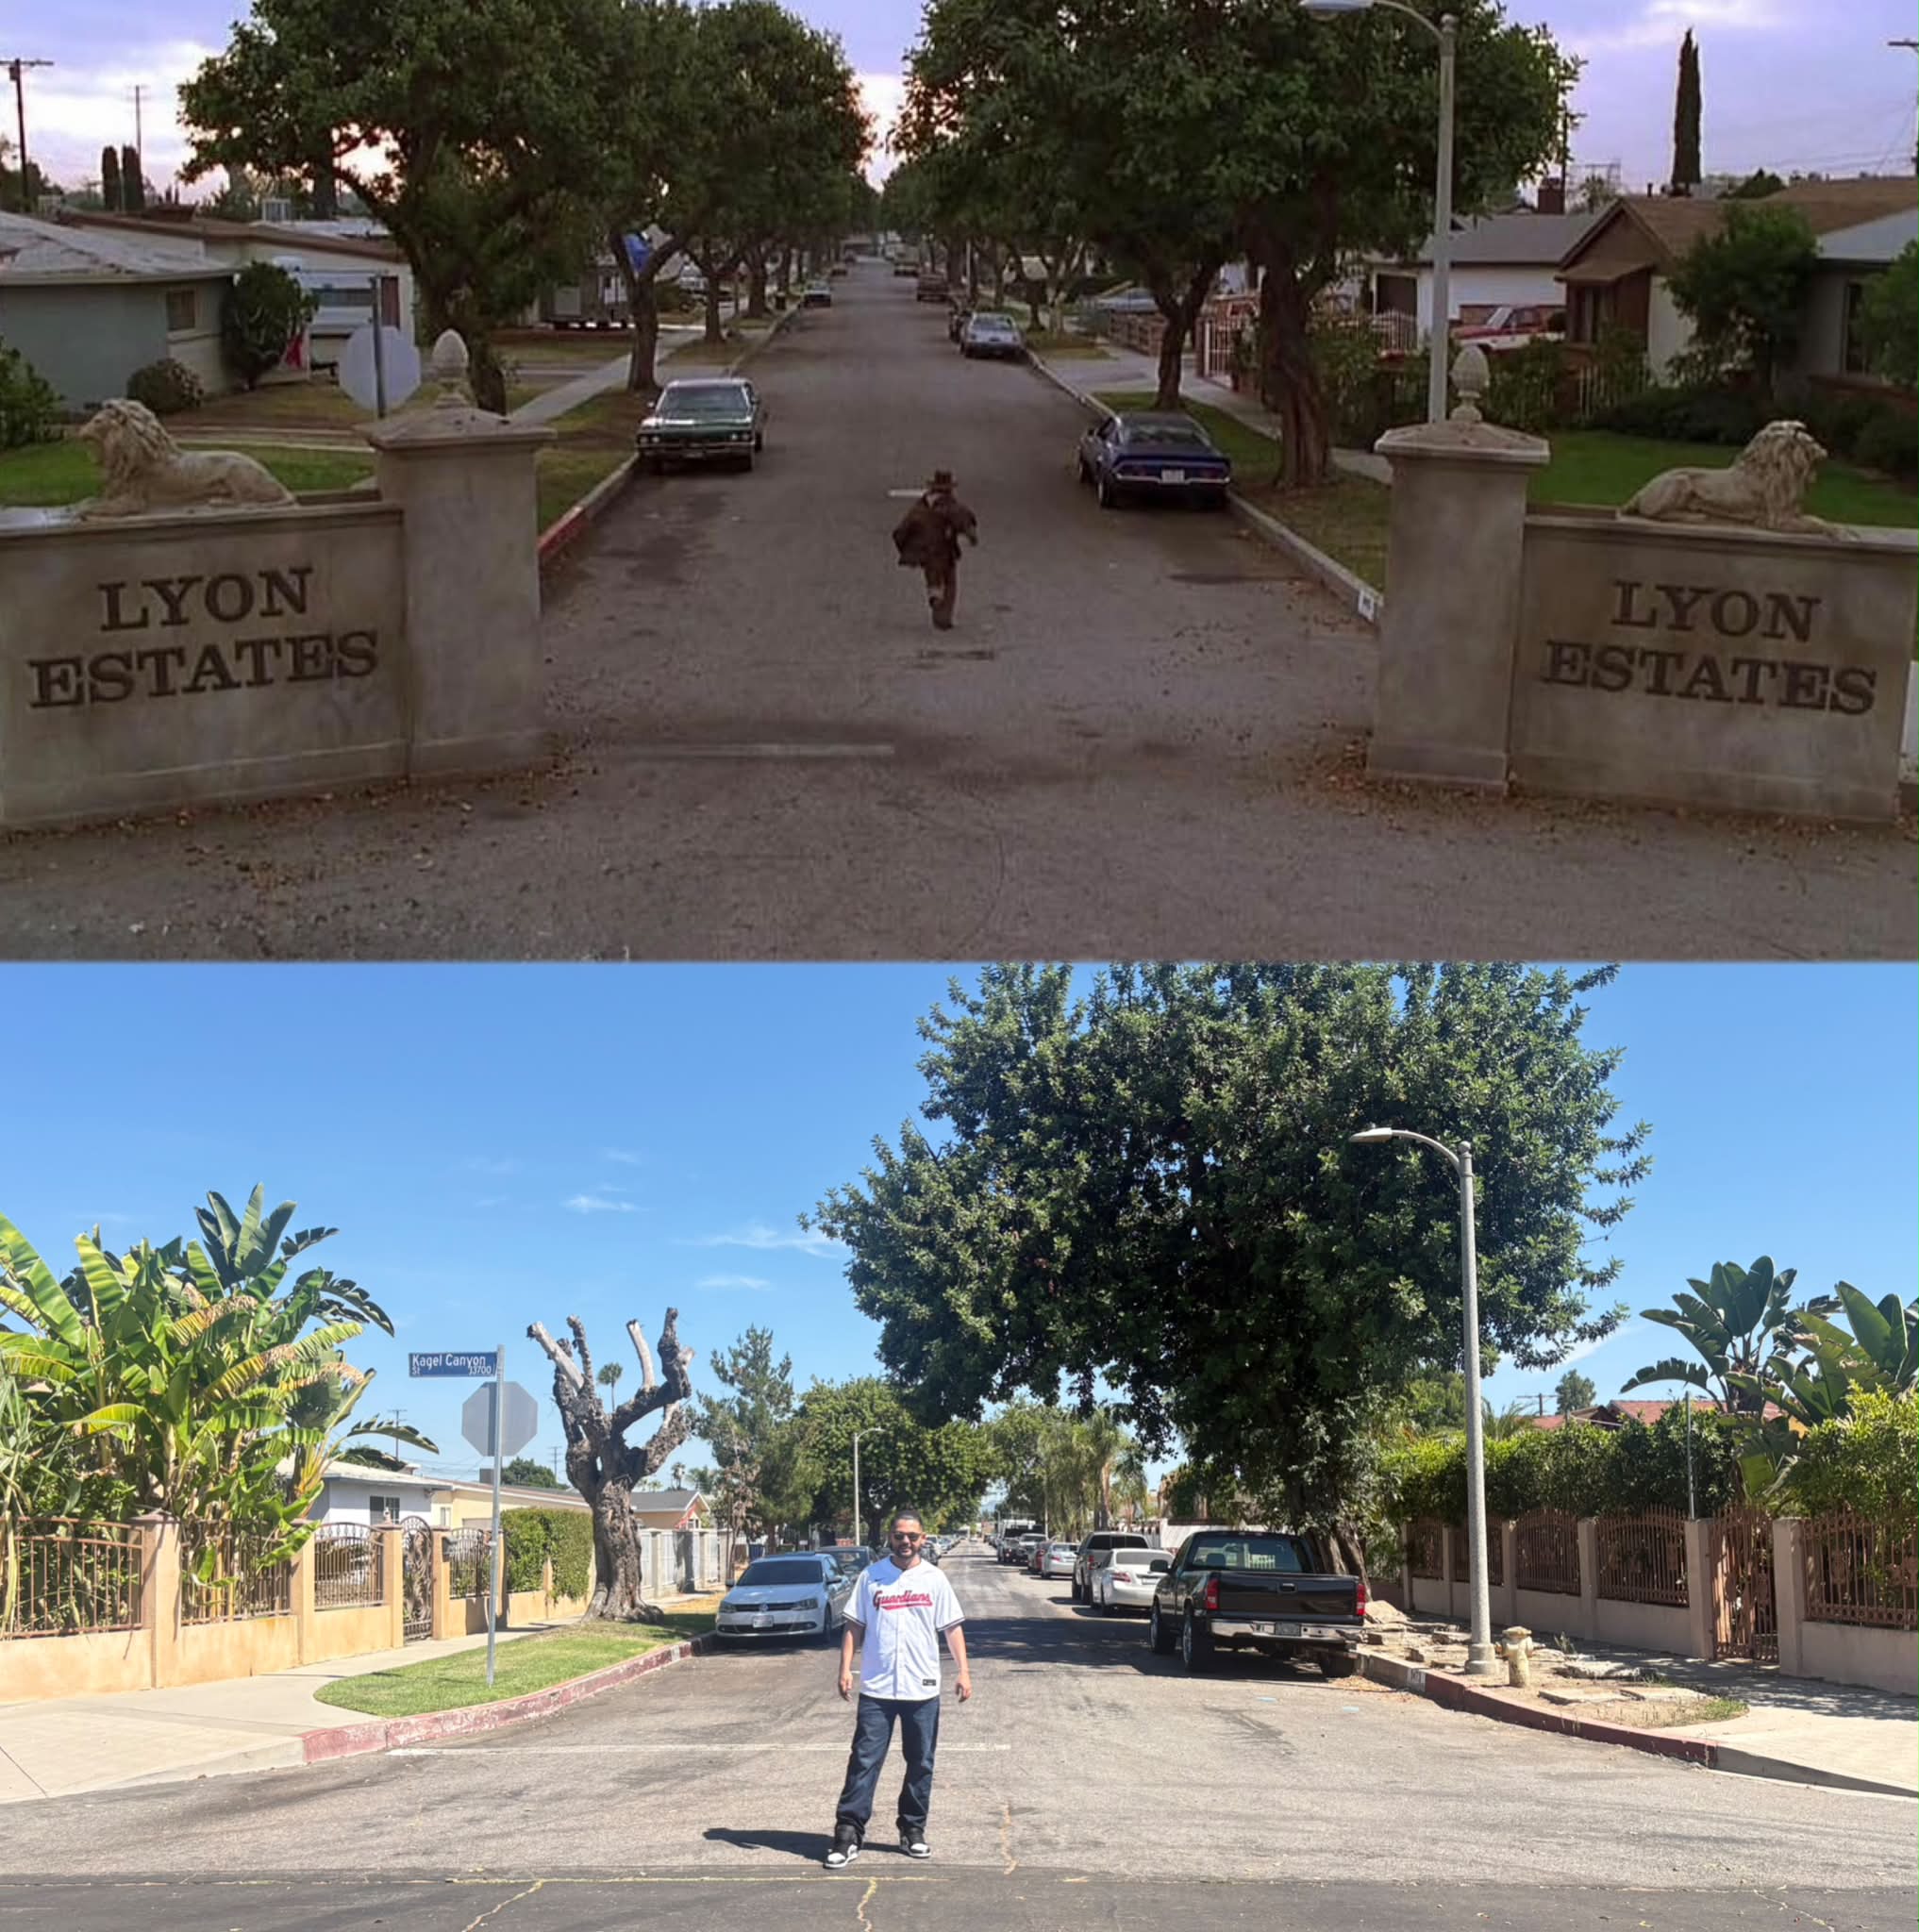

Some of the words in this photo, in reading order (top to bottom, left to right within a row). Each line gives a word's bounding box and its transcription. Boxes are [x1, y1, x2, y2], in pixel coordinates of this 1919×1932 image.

[98, 567, 313, 632] LYON
[1610, 579, 1822, 643] LYON
[28, 630, 378, 708] ESTATES
[1541, 640, 1877, 715] ESTATES
[412, 1354, 442, 1370] Kagel
[445, 1354, 486, 1369] Canyon
[873, 1590, 932, 1611] Guardians
